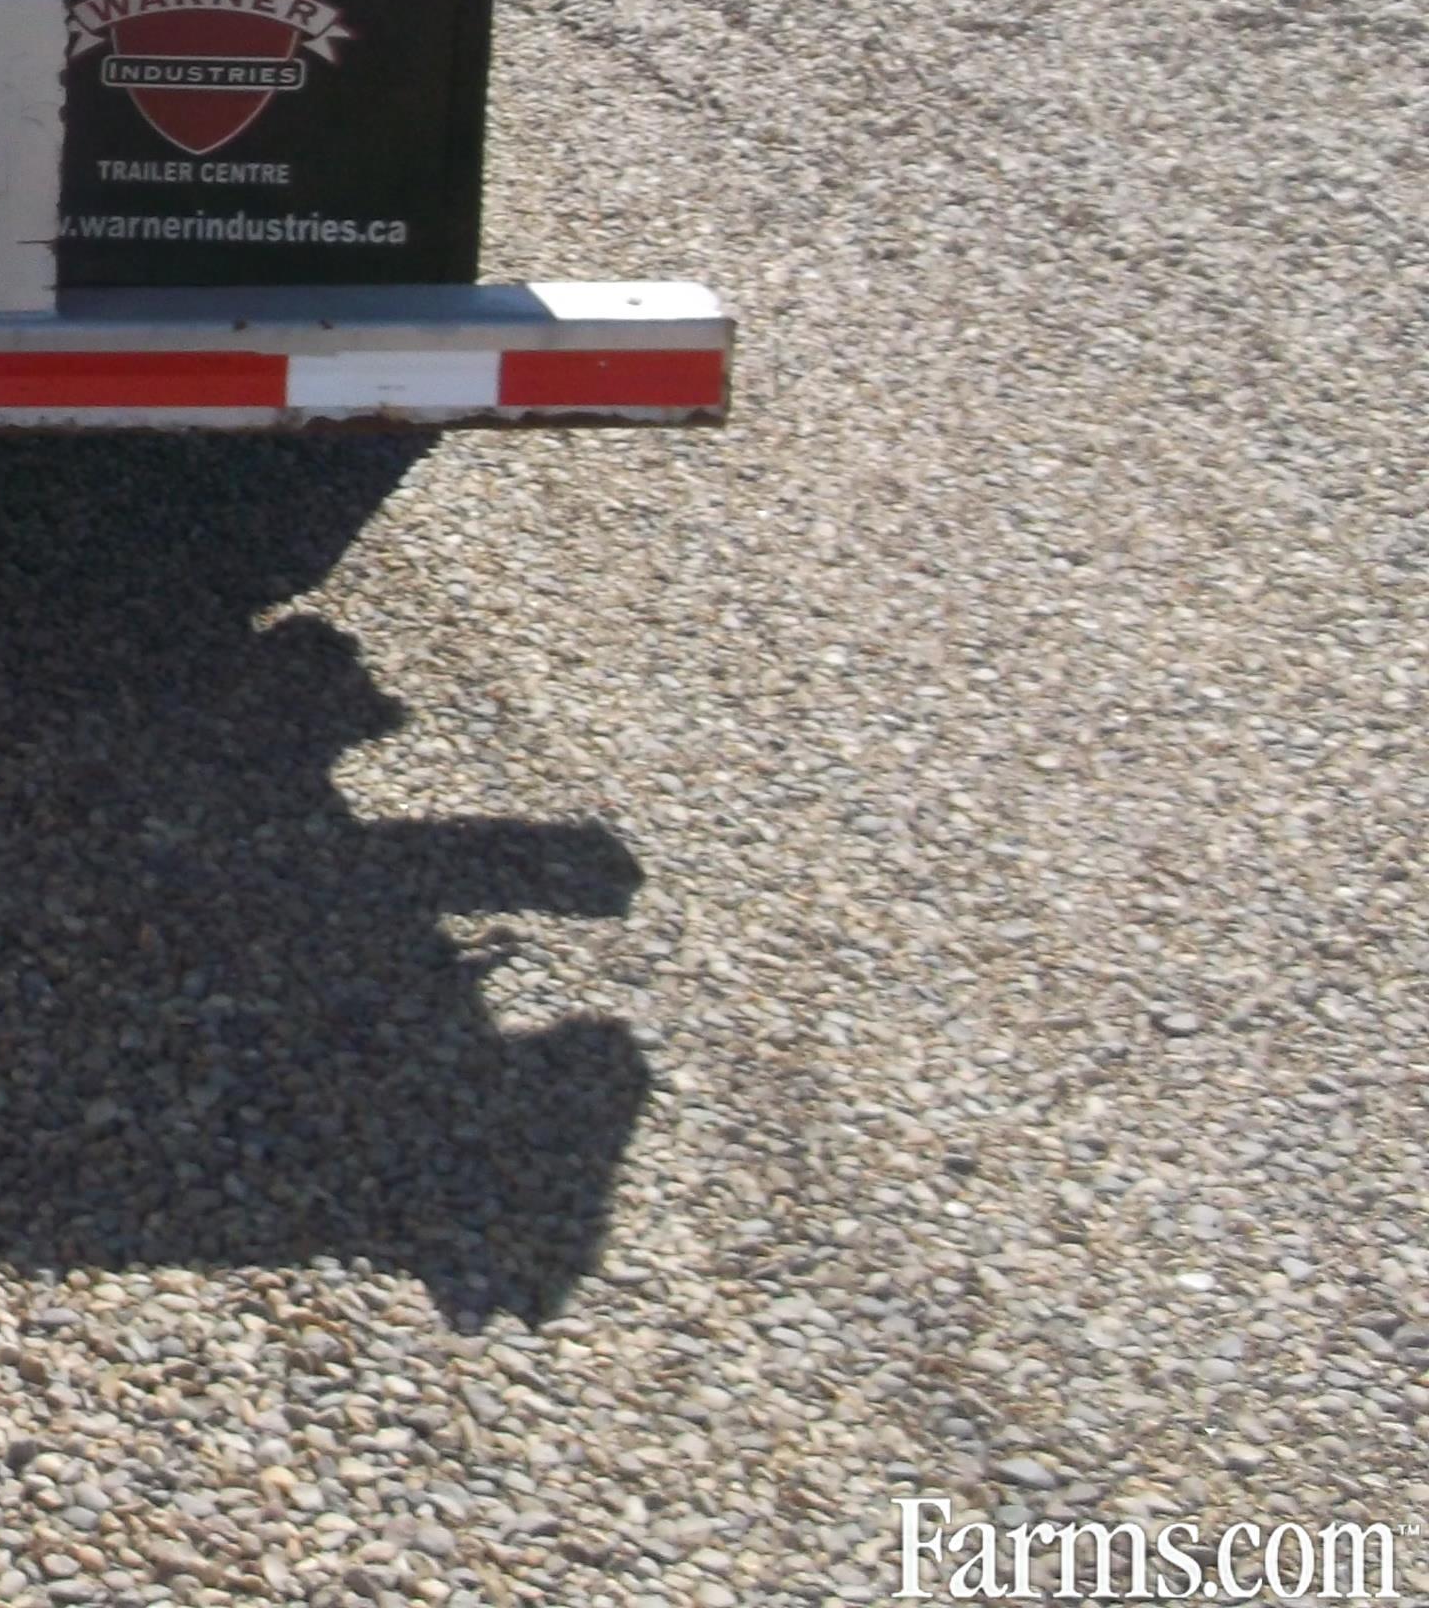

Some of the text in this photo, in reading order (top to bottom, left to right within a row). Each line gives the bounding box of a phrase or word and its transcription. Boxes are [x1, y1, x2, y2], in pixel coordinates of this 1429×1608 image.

[108, 62, 297, 85] INDUSTRIES
[97, 160, 290, 184] TRAILER CENTRE
